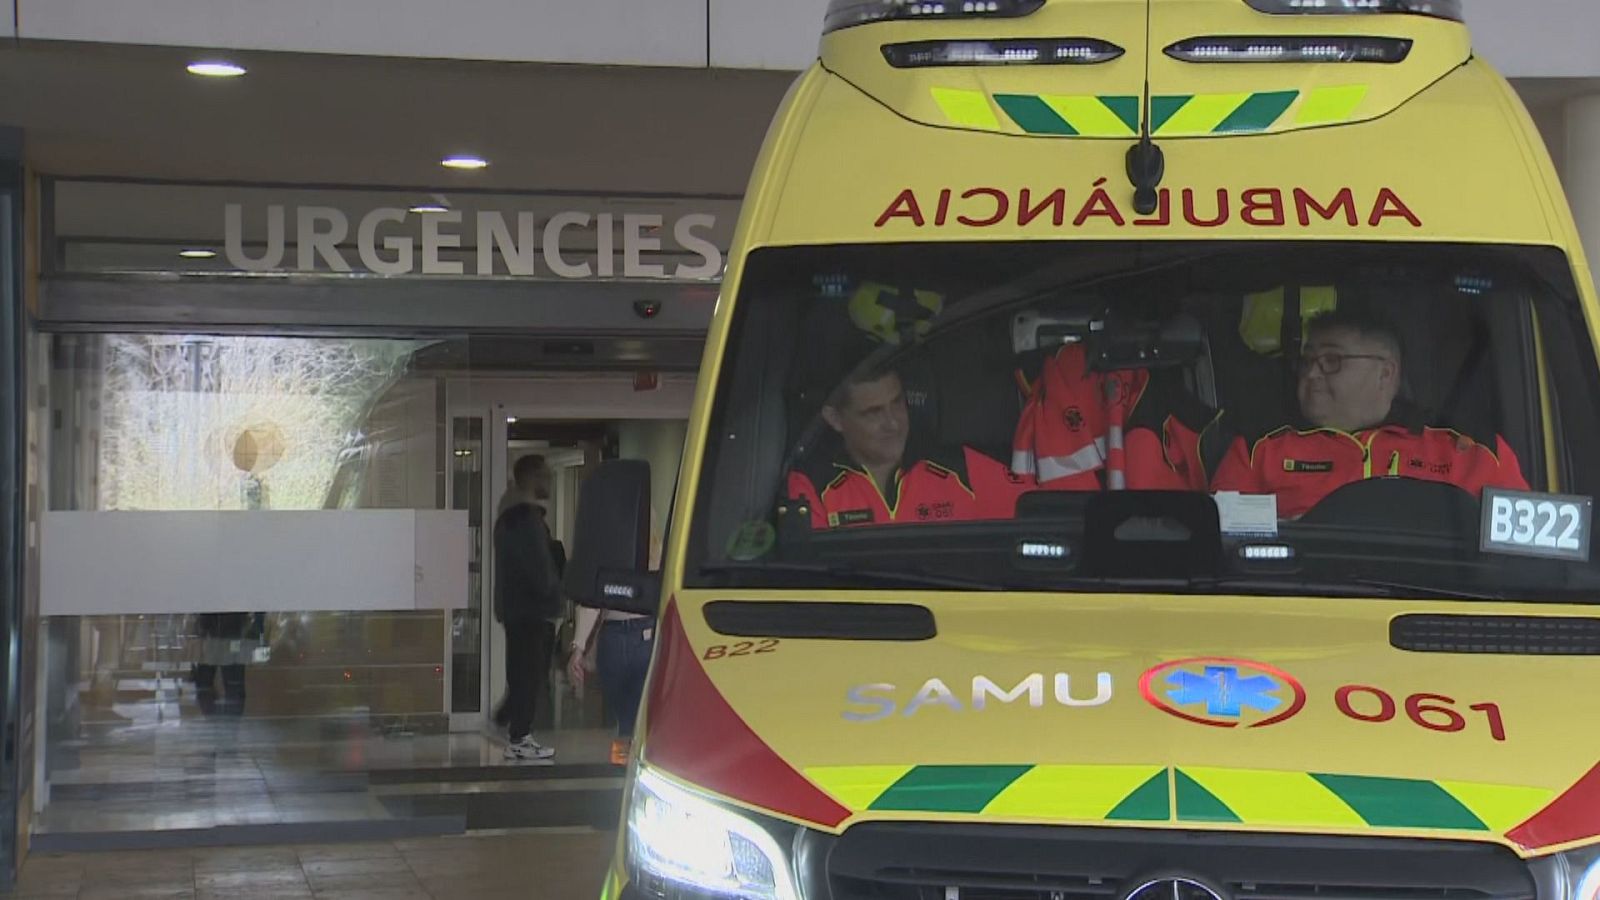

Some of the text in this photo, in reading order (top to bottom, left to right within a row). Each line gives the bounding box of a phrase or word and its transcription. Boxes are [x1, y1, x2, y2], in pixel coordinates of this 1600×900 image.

[224, 195, 722, 278] URGÈNCIES
[1491, 496, 1579, 550] B322
[703, 639, 780, 660] B22
[841, 672, 1505, 740] SAMU 061
